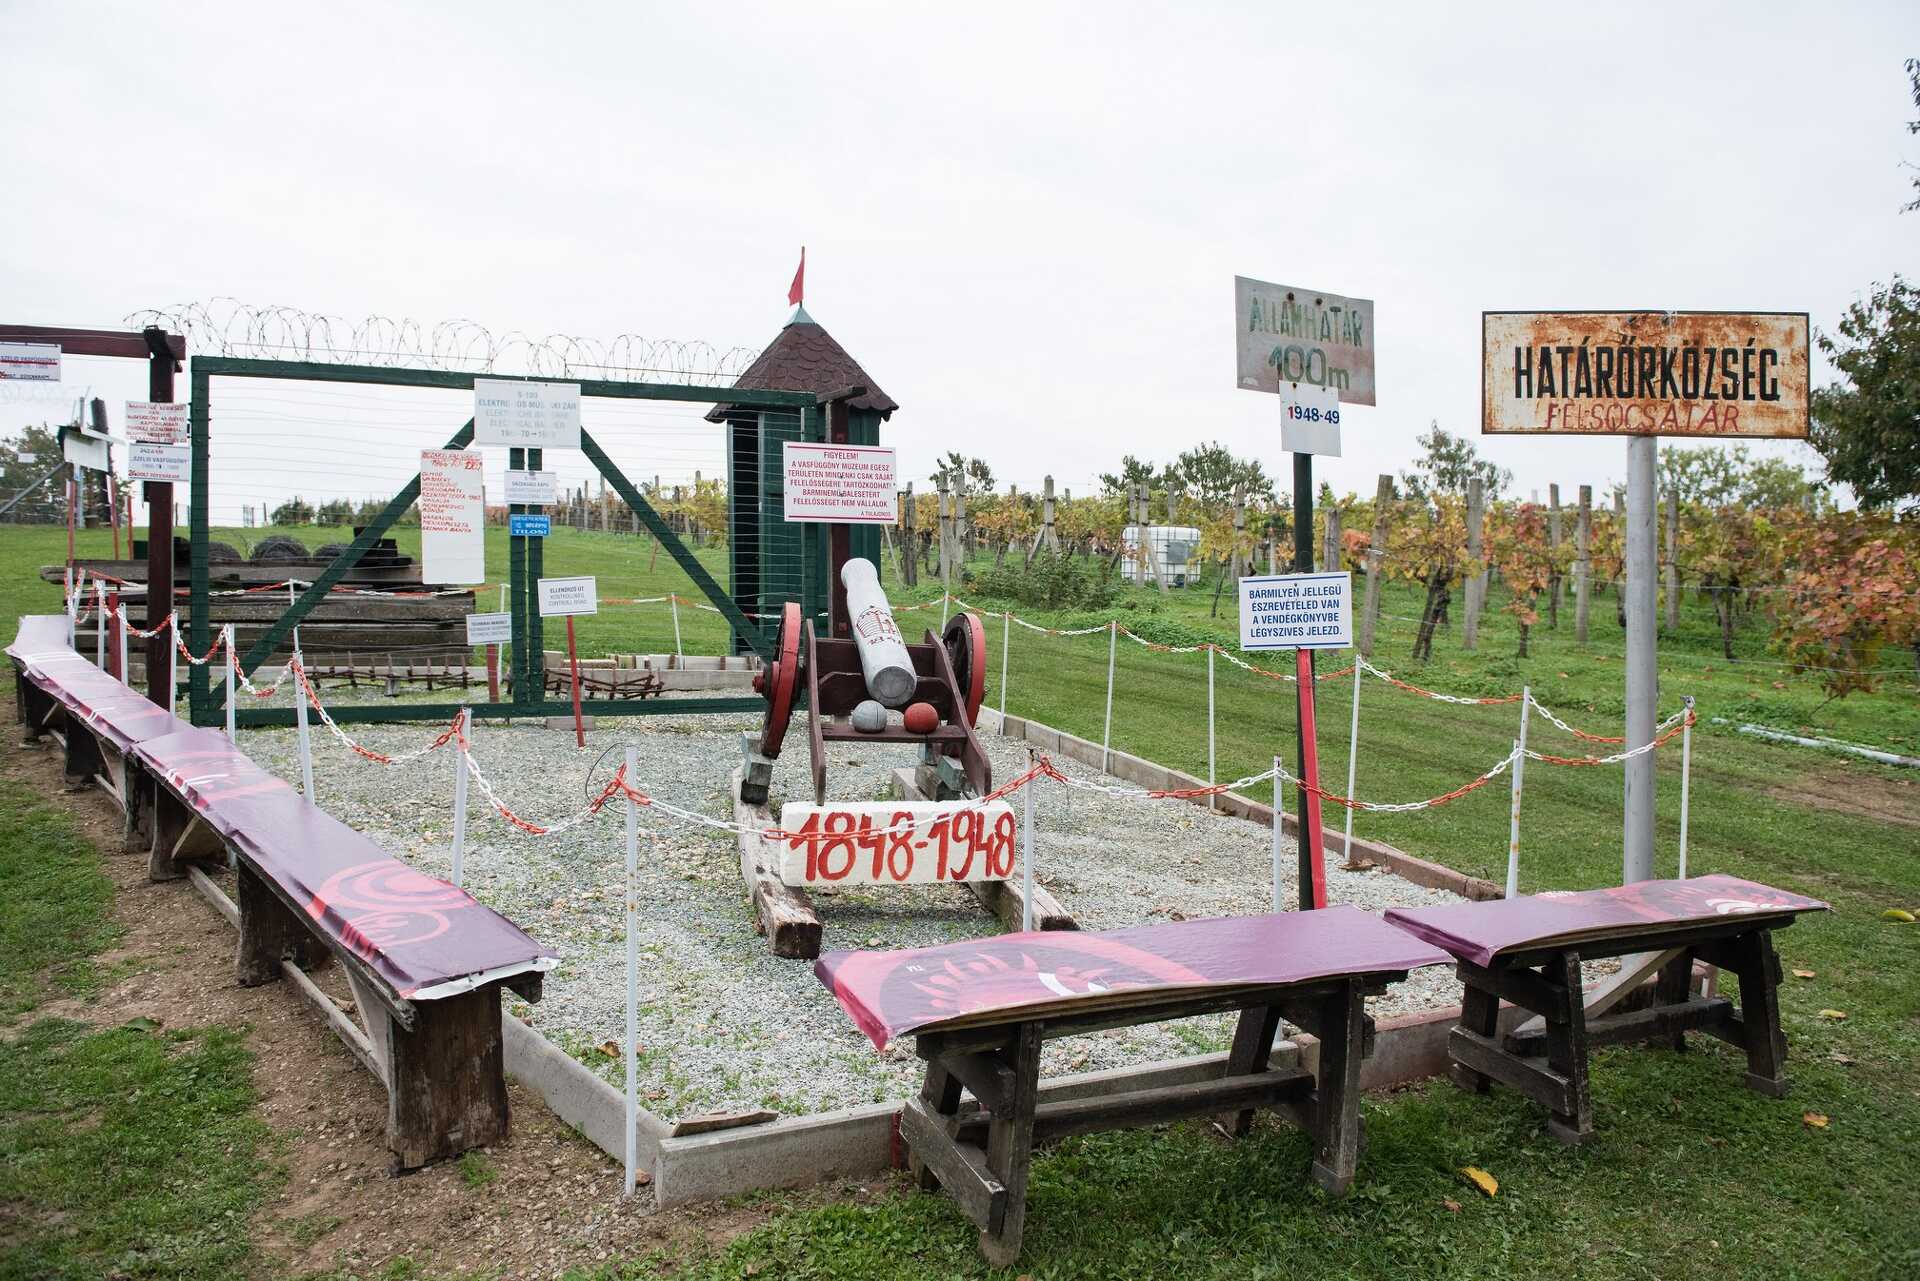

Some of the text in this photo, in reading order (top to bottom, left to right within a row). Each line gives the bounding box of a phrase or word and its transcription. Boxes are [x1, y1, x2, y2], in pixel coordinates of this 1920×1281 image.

[1287, 405, 1340, 424] 1948-49
[823, 451, 859, 460] FIGYELEM!
[825, 470, 856, 479] MINDENKI
[857, 472, 873, 480] CSAK
[841, 499, 856, 507] NEM
[1249, 587, 1300, 600] BÁRMILYEN
[1251, 599, 1340, 612] ÉSZREVÉTELED VAN
[1252, 615, 1259, 625] A
[789, 808, 1016, 882] 1848-1948
